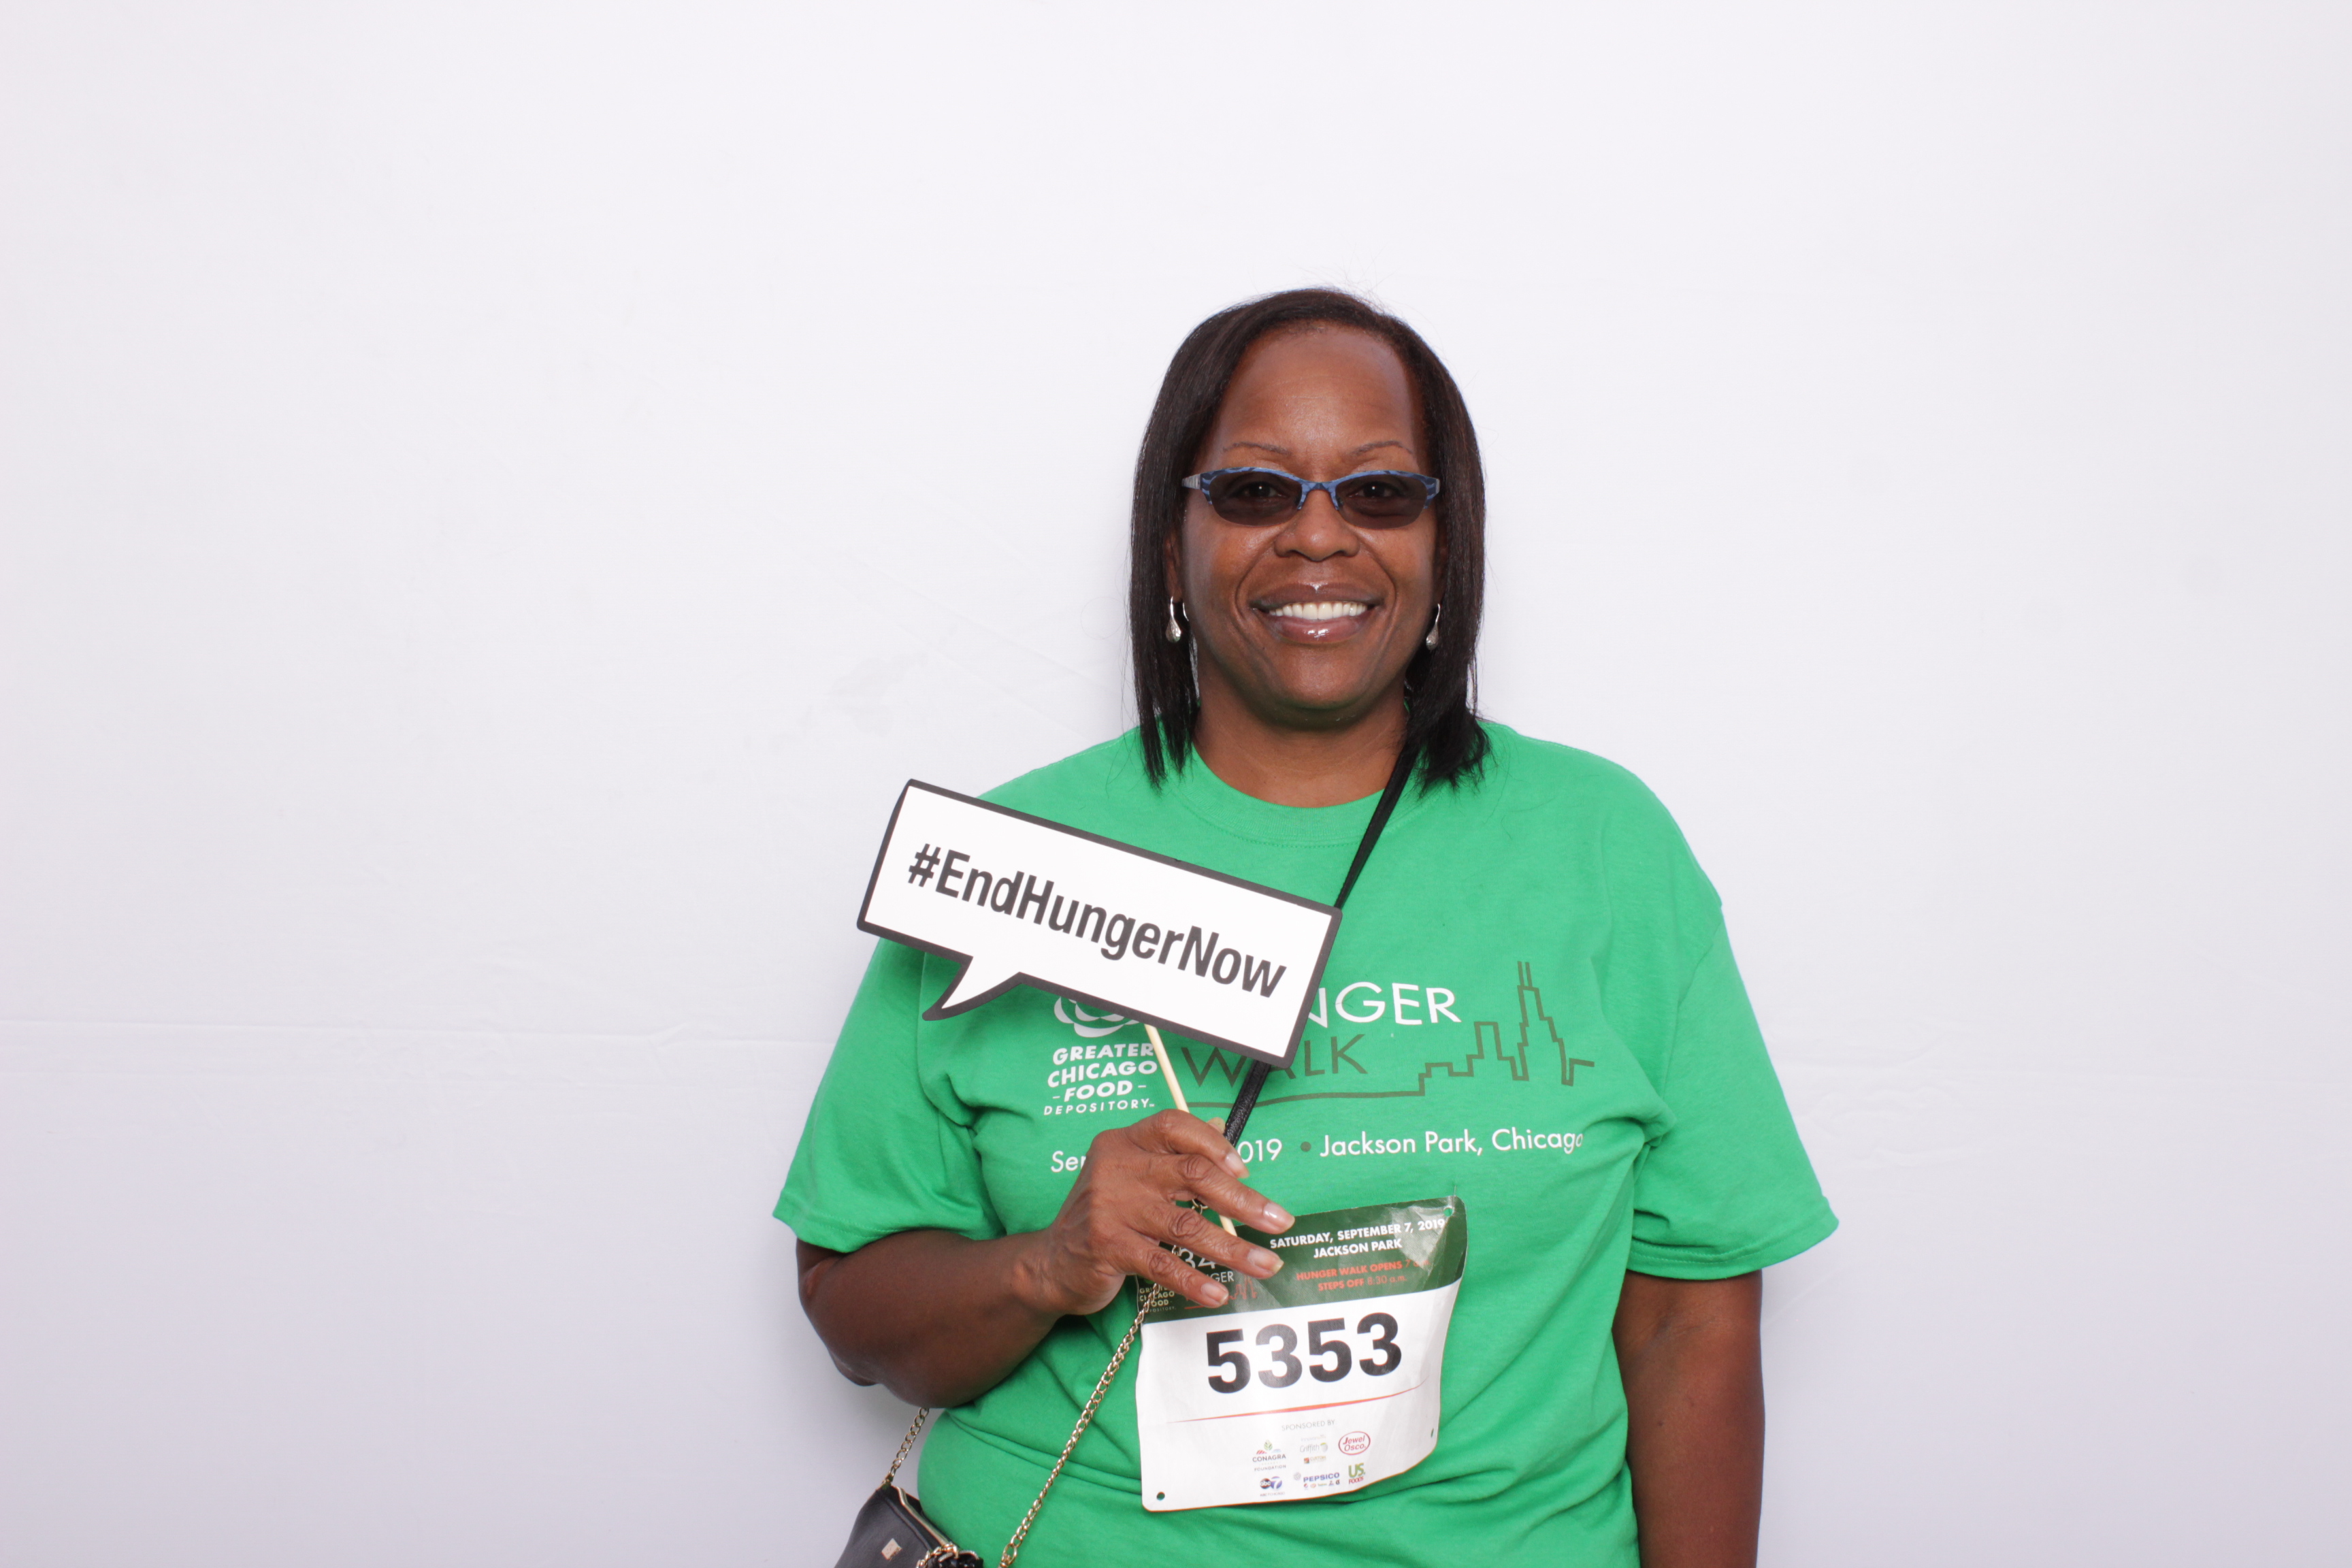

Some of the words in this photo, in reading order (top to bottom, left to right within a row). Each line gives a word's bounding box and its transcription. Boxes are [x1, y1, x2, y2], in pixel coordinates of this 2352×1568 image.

[908, 843, 1287, 998] #EndHungerNow
[1309, 981, 1461, 1028] GER
[1052, 1043, 1154, 1066] GREATER
[1181, 1033, 1368, 1088] WLK
[1047, 1060, 1158, 1088] CHICAGO
[1237, 1138, 1283, 1163] 019
[1320, 1131, 1416, 1157] Jackson
[1424, 1128, 1483, 1156] Park,
[1491, 1126, 1584, 1155] Chicago
[1270, 1231, 1334, 1249] SATURDAY,
[1337, 1224, 1402, 1241] SEPTEMBER
[1404, 1222, 1414, 1234] 7,
[1417, 1218, 1446, 1231] 2019
[1313, 1242, 1369, 1258] JACKSON
[1371, 1239, 1403, 1252] PARK
[1206, 1271, 1235, 1282] GER
[1296, 1269, 1338, 1281] HUNGER
[1339, 1266, 1368, 1276] WALK
[1369, 1261, 1403, 1273] OPENS
[1318, 1281, 1345, 1292] STEPS
[1347, 1278, 1365, 1288] OFF
[1367, 1275, 1388, 1286] 8:30
[1390, 1274, 1407, 1283] a.m.
[1150, 1299, 1169, 1307] OOD
[1205, 1311, 1402, 1394] 5353
[1281, 1420, 1326, 1431] SPONSORED
[1300, 1443, 1320, 1453] Griffith
[1343, 1435, 1365, 1445] Jewel
[1252, 1454, 1286, 1463] CONAGRA
[1303, 1472, 1340, 1482] PEPSICO
[1349, 1476, 1364, 1484] FOODS
